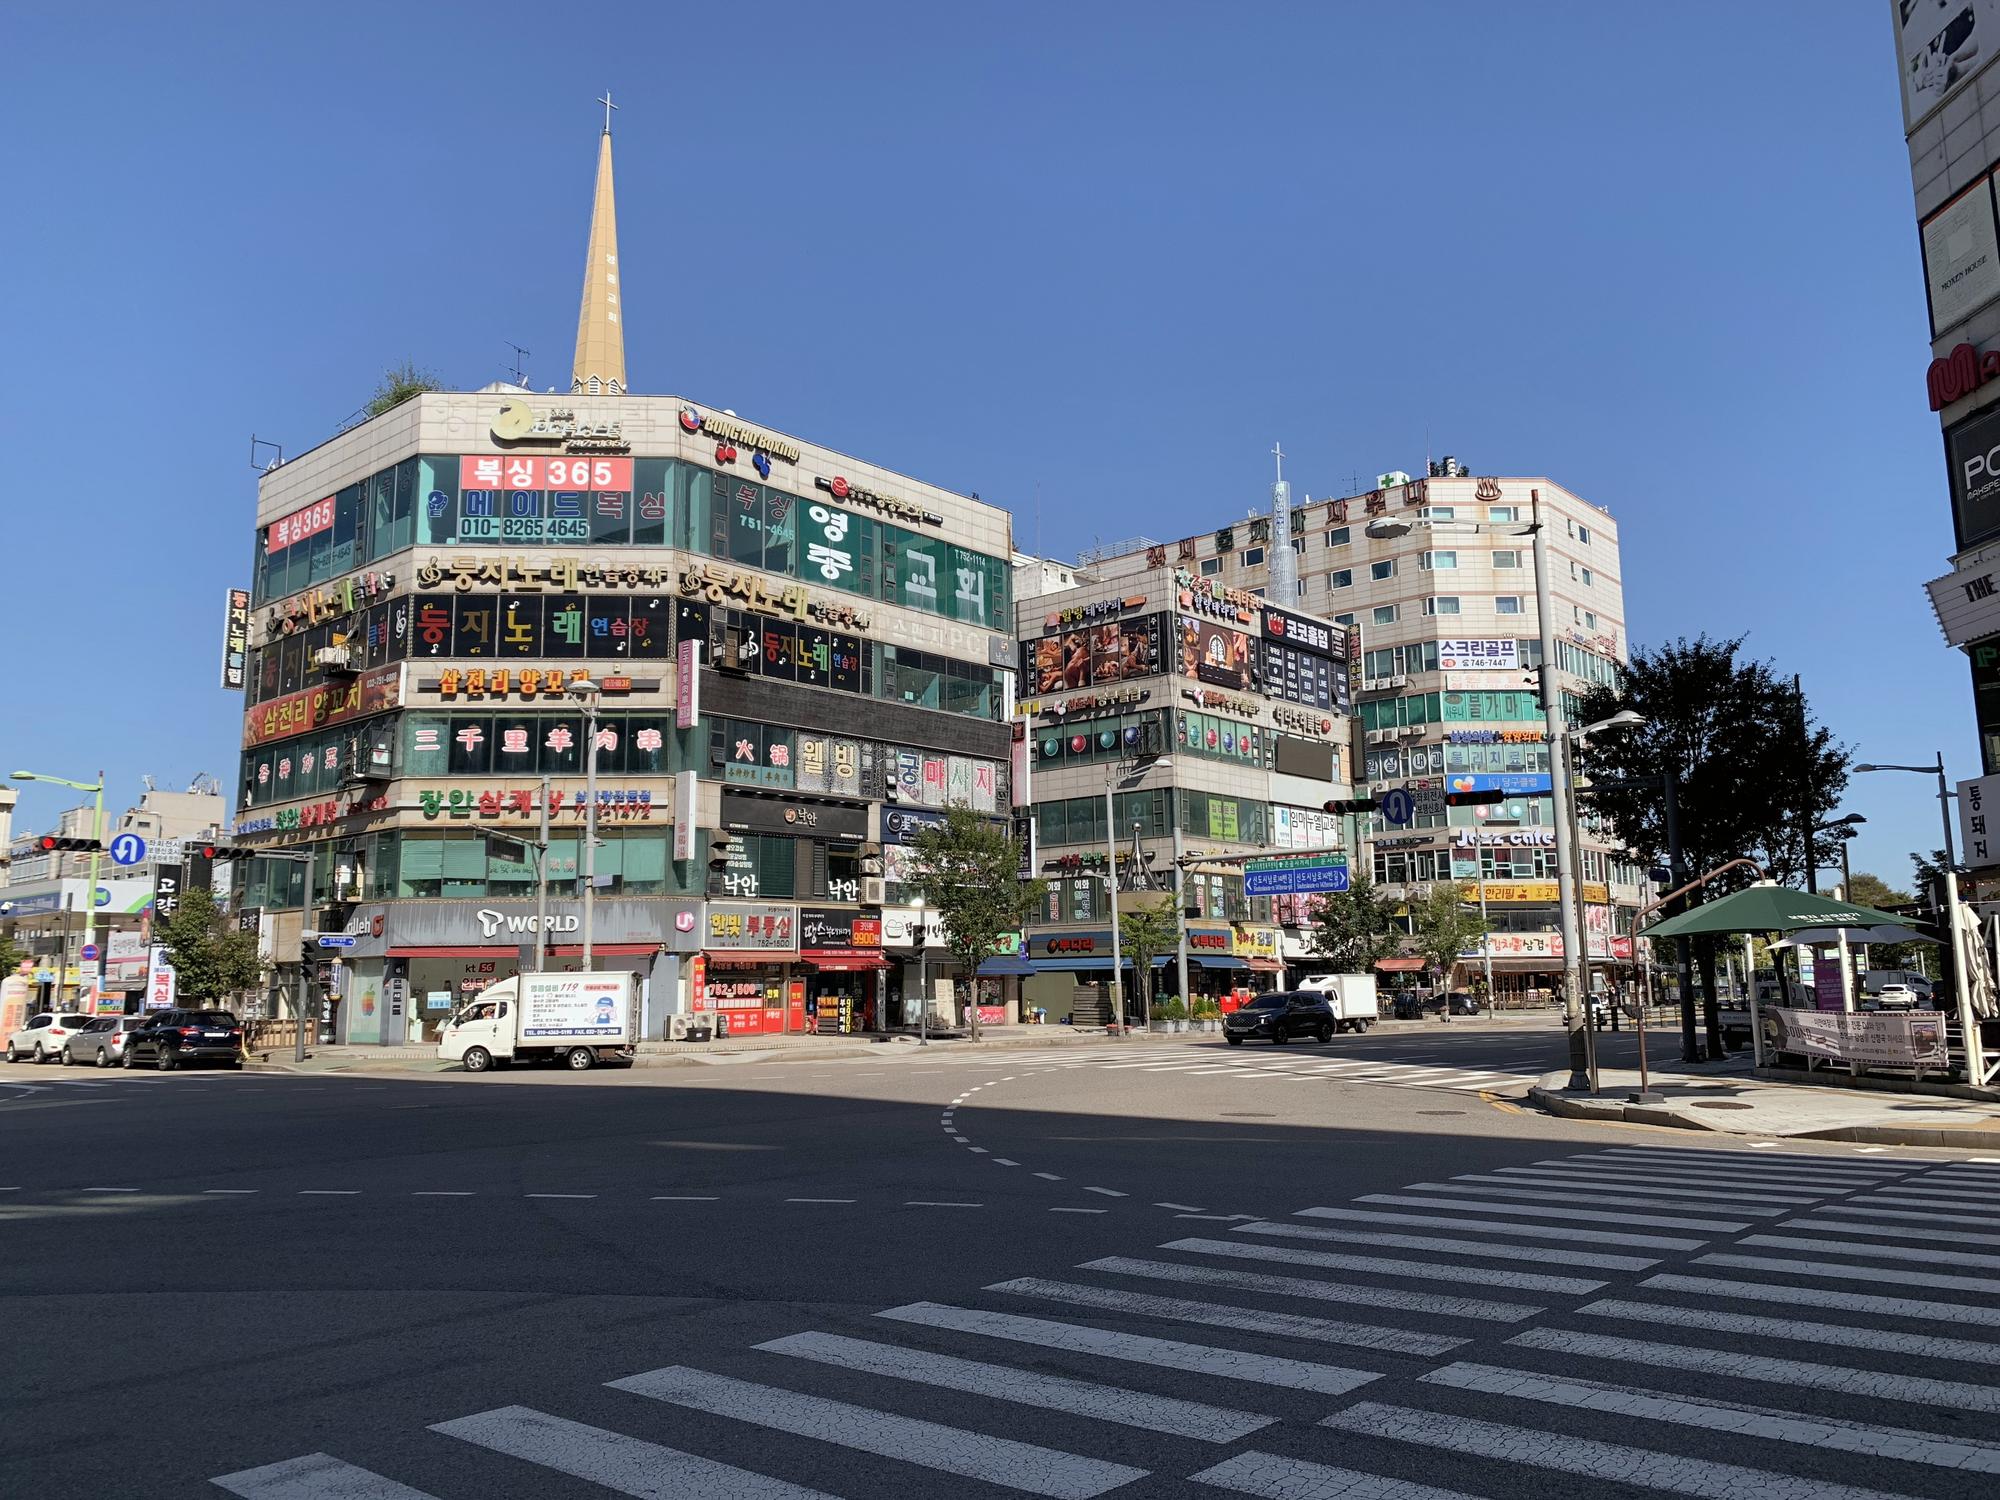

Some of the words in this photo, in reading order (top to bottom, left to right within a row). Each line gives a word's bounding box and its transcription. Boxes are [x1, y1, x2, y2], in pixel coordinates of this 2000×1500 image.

[757, 435, 800, 462] Boxing
[474, 459, 534, 488] 복싱
[548, 460, 612, 485] 365
[466, 490, 581, 518] 메이드
[597, 492, 666, 520] 복싱
[734, 484, 791, 521] 복싱
[277, 519, 302, 544] 복싱
[303, 501, 331, 533] 365
[806, 505, 854, 580] 영종
[449, 556, 580, 592] 둥지노래
[904, 549, 985, 618] 교회
[701, 565, 812, 622] 둥지노래
[417, 609, 583, 644] 둥지노래
[591, 617, 649, 637] 연습장
[1286, 619, 1329, 651] 코코홀덤
[763, 631, 829, 672] 둥지노래
[1441, 641, 1515, 657] 스크린골프
[1470, 659, 1508, 667] 746-7447
[1445, 705, 1465, 719] 사우나
[1469, 694, 1518, 719] 불가마
[413, 728, 663, 752] 三千里羊肉串
[803, 739, 855, 780] 웰빙
[1450, 751, 1521, 769] 물리치료
[924, 759, 993, 797] 마사지
[797, 807, 818, 827] 낙안
[1290, 811, 1337, 834] 임마누엘교회
[1969, 785, 1989, 859] 통돼지
[1456, 828, 1504, 848] Jazz
[1510, 828, 1555, 847] cafe
[723, 873, 759, 898] 낙안
[828, 878, 860, 901] 낙안
[1046, 881, 1061, 891] 이화
[1074, 879, 1090, 890] 이화
[710, 912, 743, 938] 한빛
[746, 915, 793, 940] 부동산
[757, 939, 790, 949] 752-1500
[154, 973, 170, 1002] 복싱
[560, 983, 579, 992] 119
